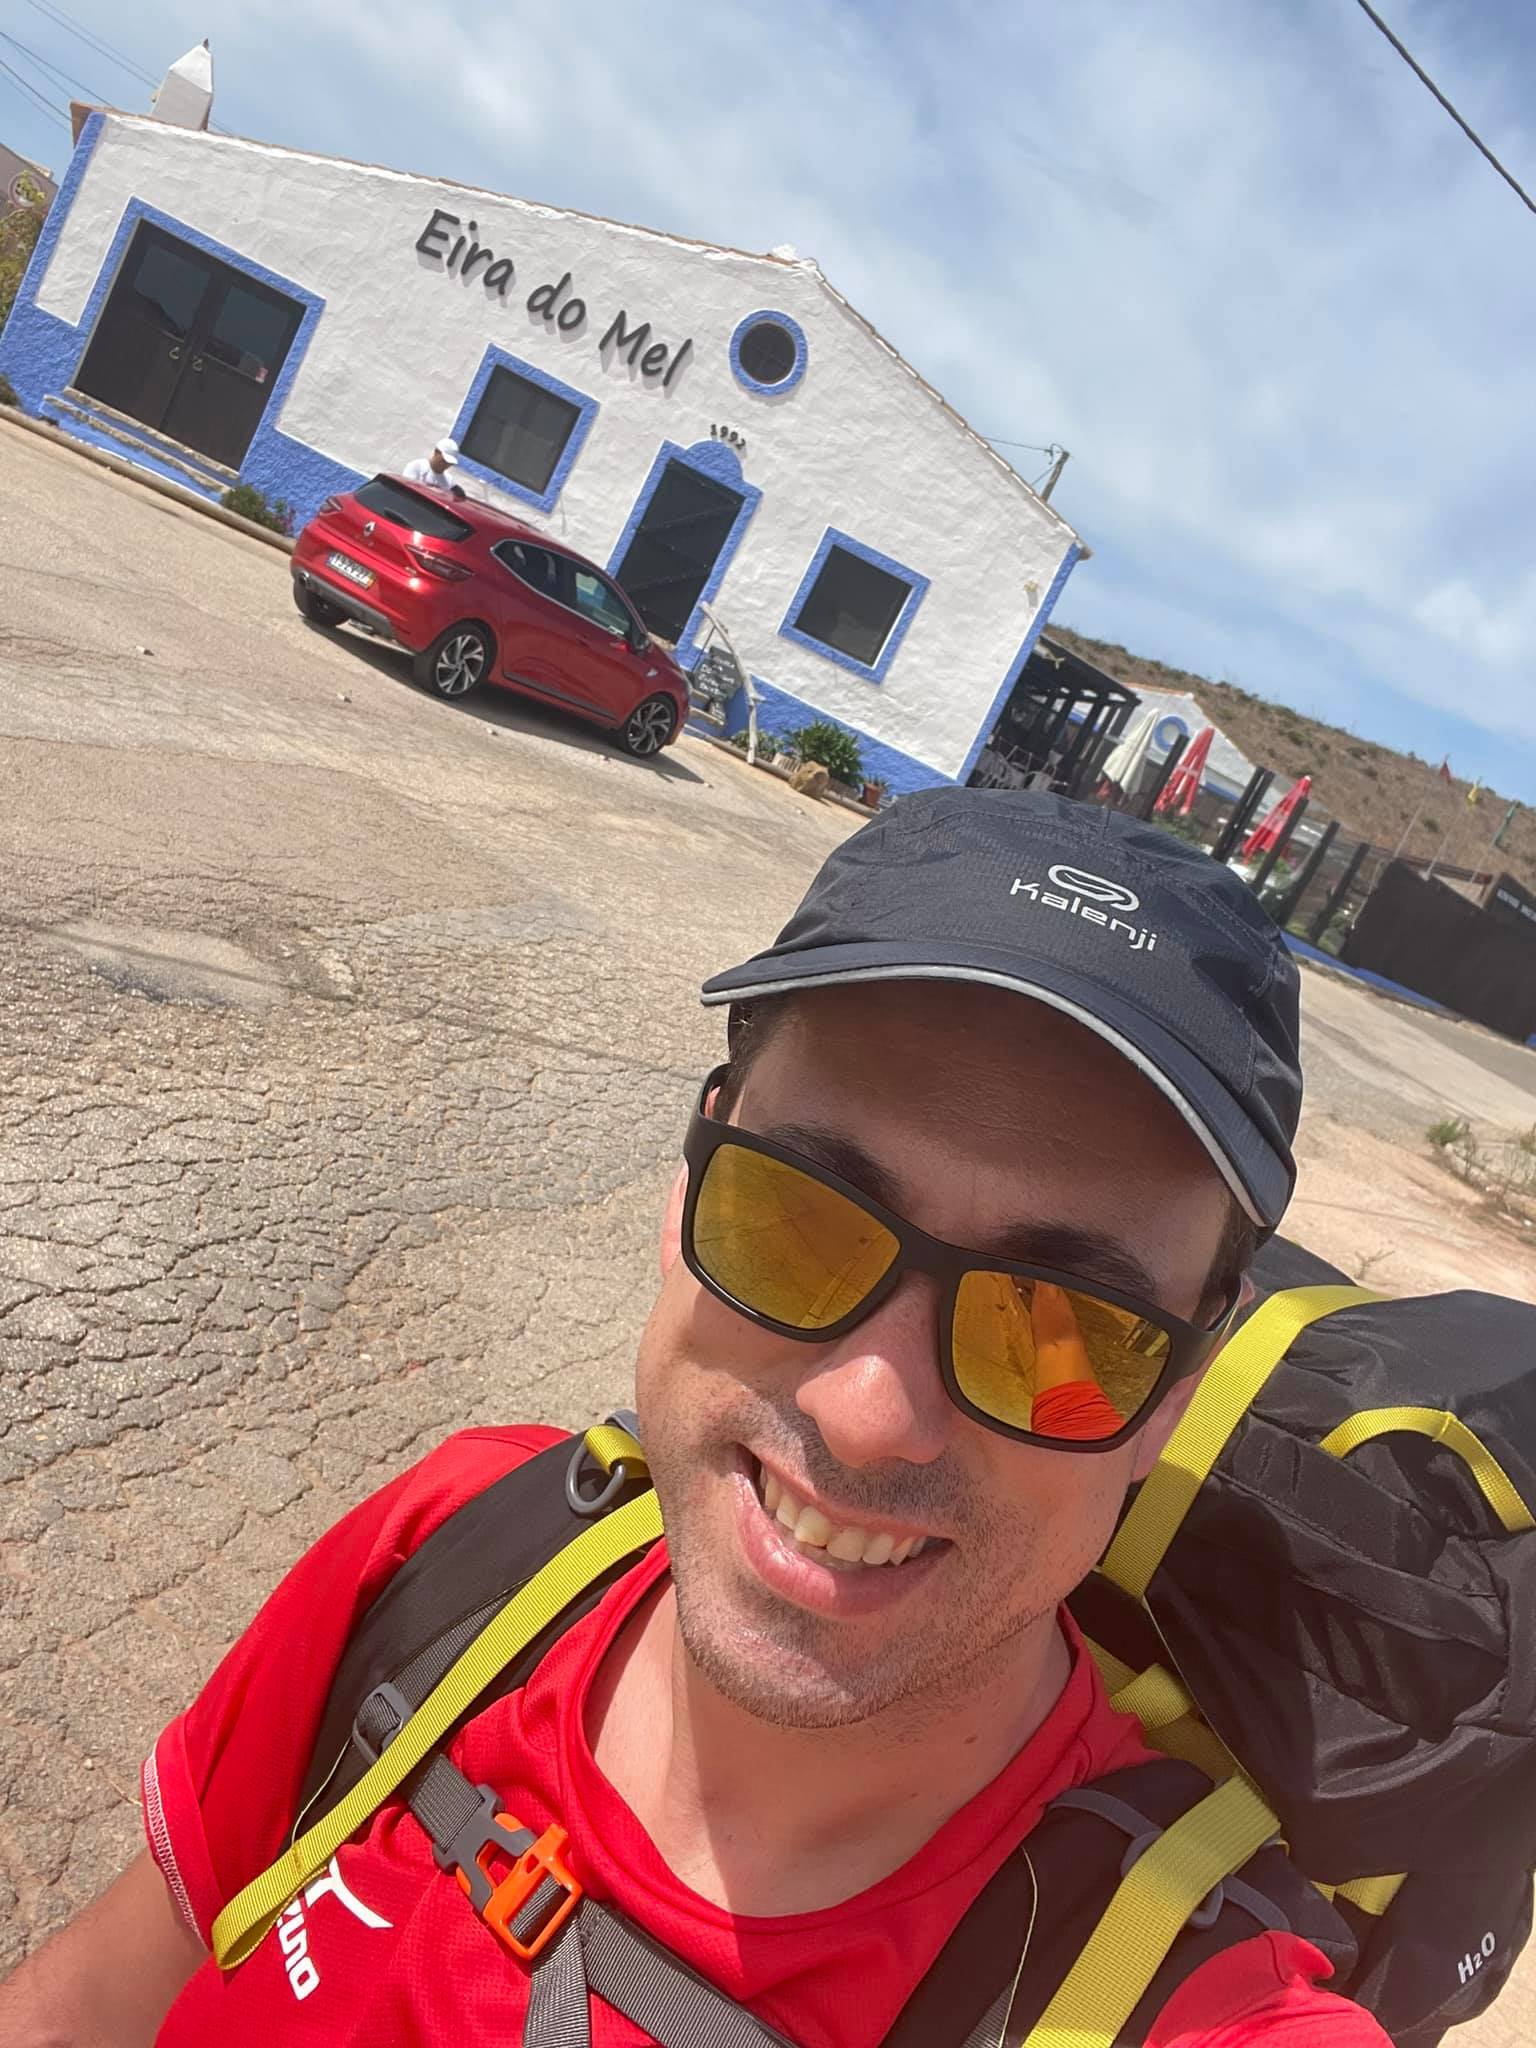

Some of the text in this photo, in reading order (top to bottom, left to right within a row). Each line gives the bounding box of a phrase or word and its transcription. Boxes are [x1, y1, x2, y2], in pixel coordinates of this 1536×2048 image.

[415, 208, 693, 387] Eira do Mel
[711, 423, 746, 450] 1992
[1010, 878, 1157, 951] Kalenji
